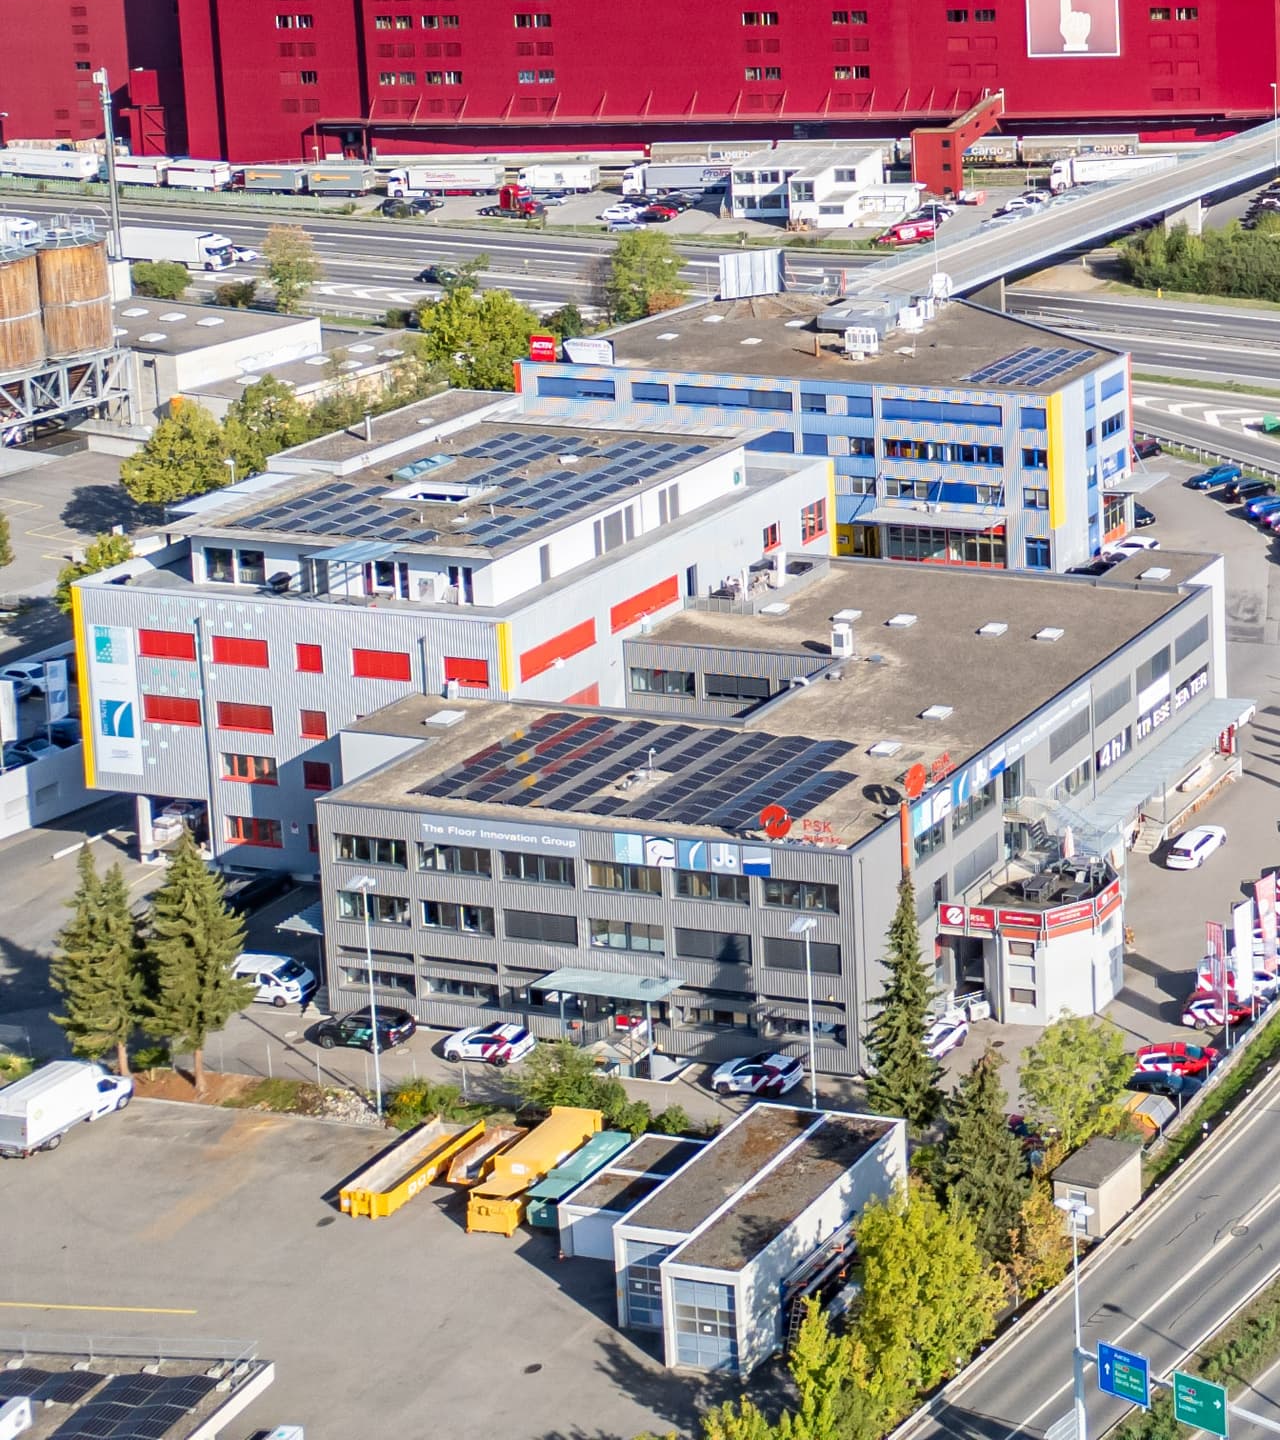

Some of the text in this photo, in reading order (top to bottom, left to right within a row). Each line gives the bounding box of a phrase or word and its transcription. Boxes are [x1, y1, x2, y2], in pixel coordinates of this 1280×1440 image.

[1093, 144, 1126, 155] cargo
[421, 822, 577, 849] The Floor Innovation Group
